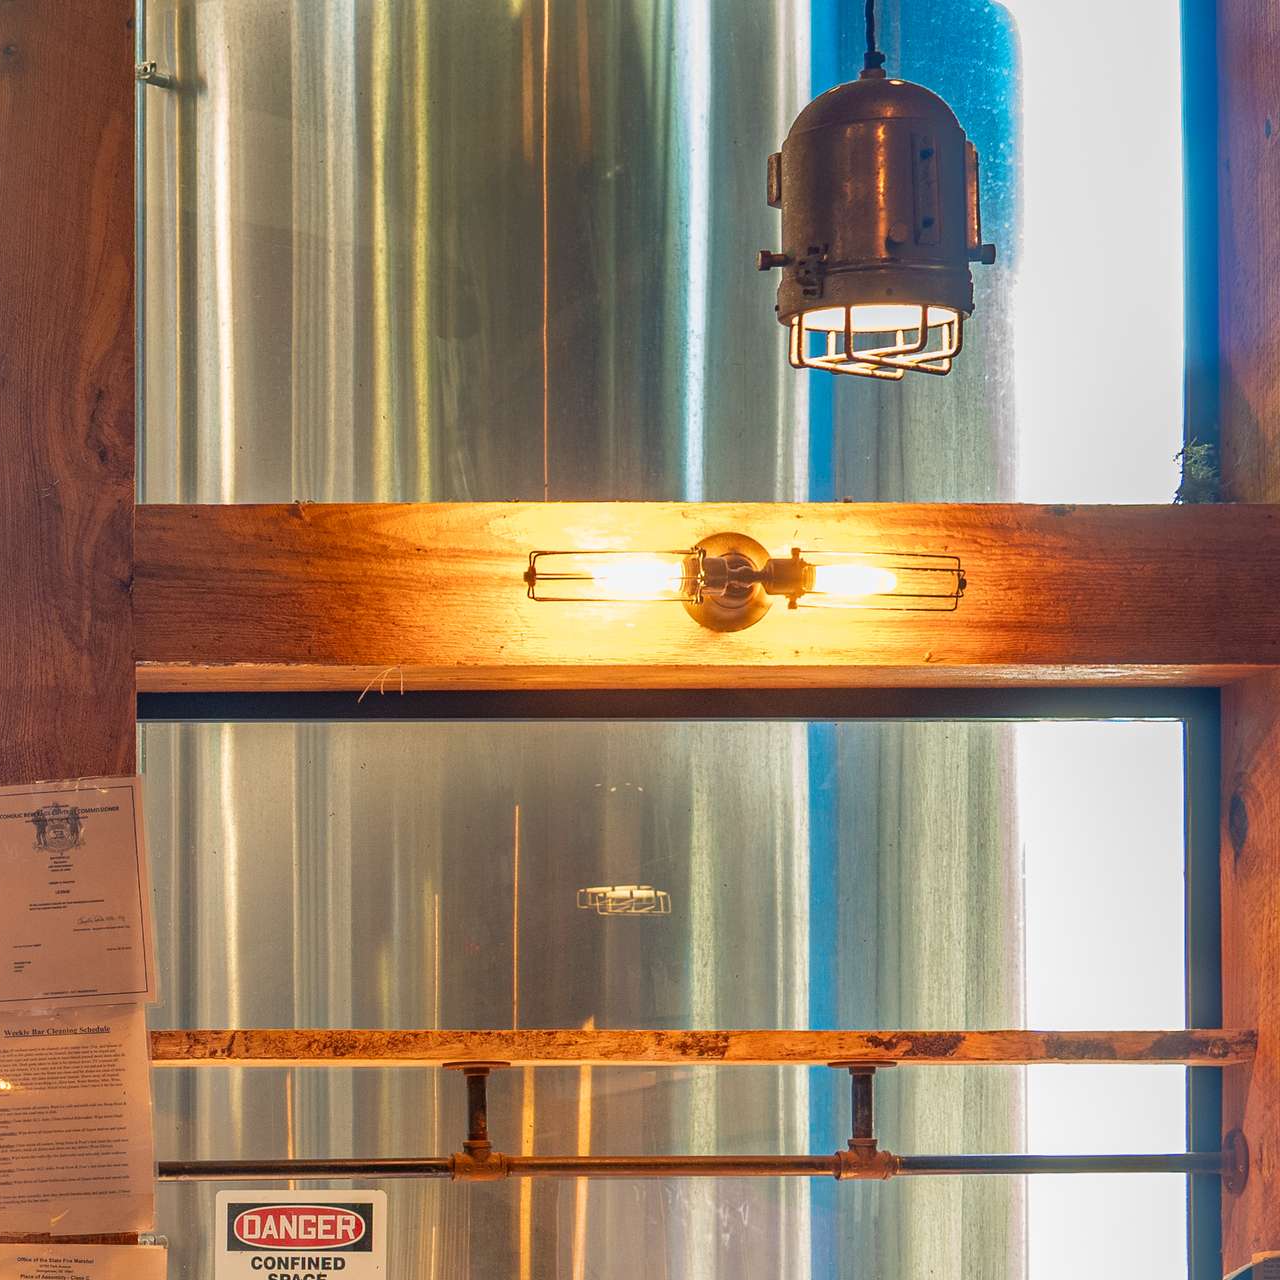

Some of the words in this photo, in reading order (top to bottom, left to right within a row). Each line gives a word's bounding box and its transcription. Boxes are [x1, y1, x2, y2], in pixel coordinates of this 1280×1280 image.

[32, 1028, 45, 1036] Bar
[80, 1025, 111, 1033] Schedule
[243, 1215, 356, 1239] DANGER
[251, 1256, 346, 1271] CONFINED
